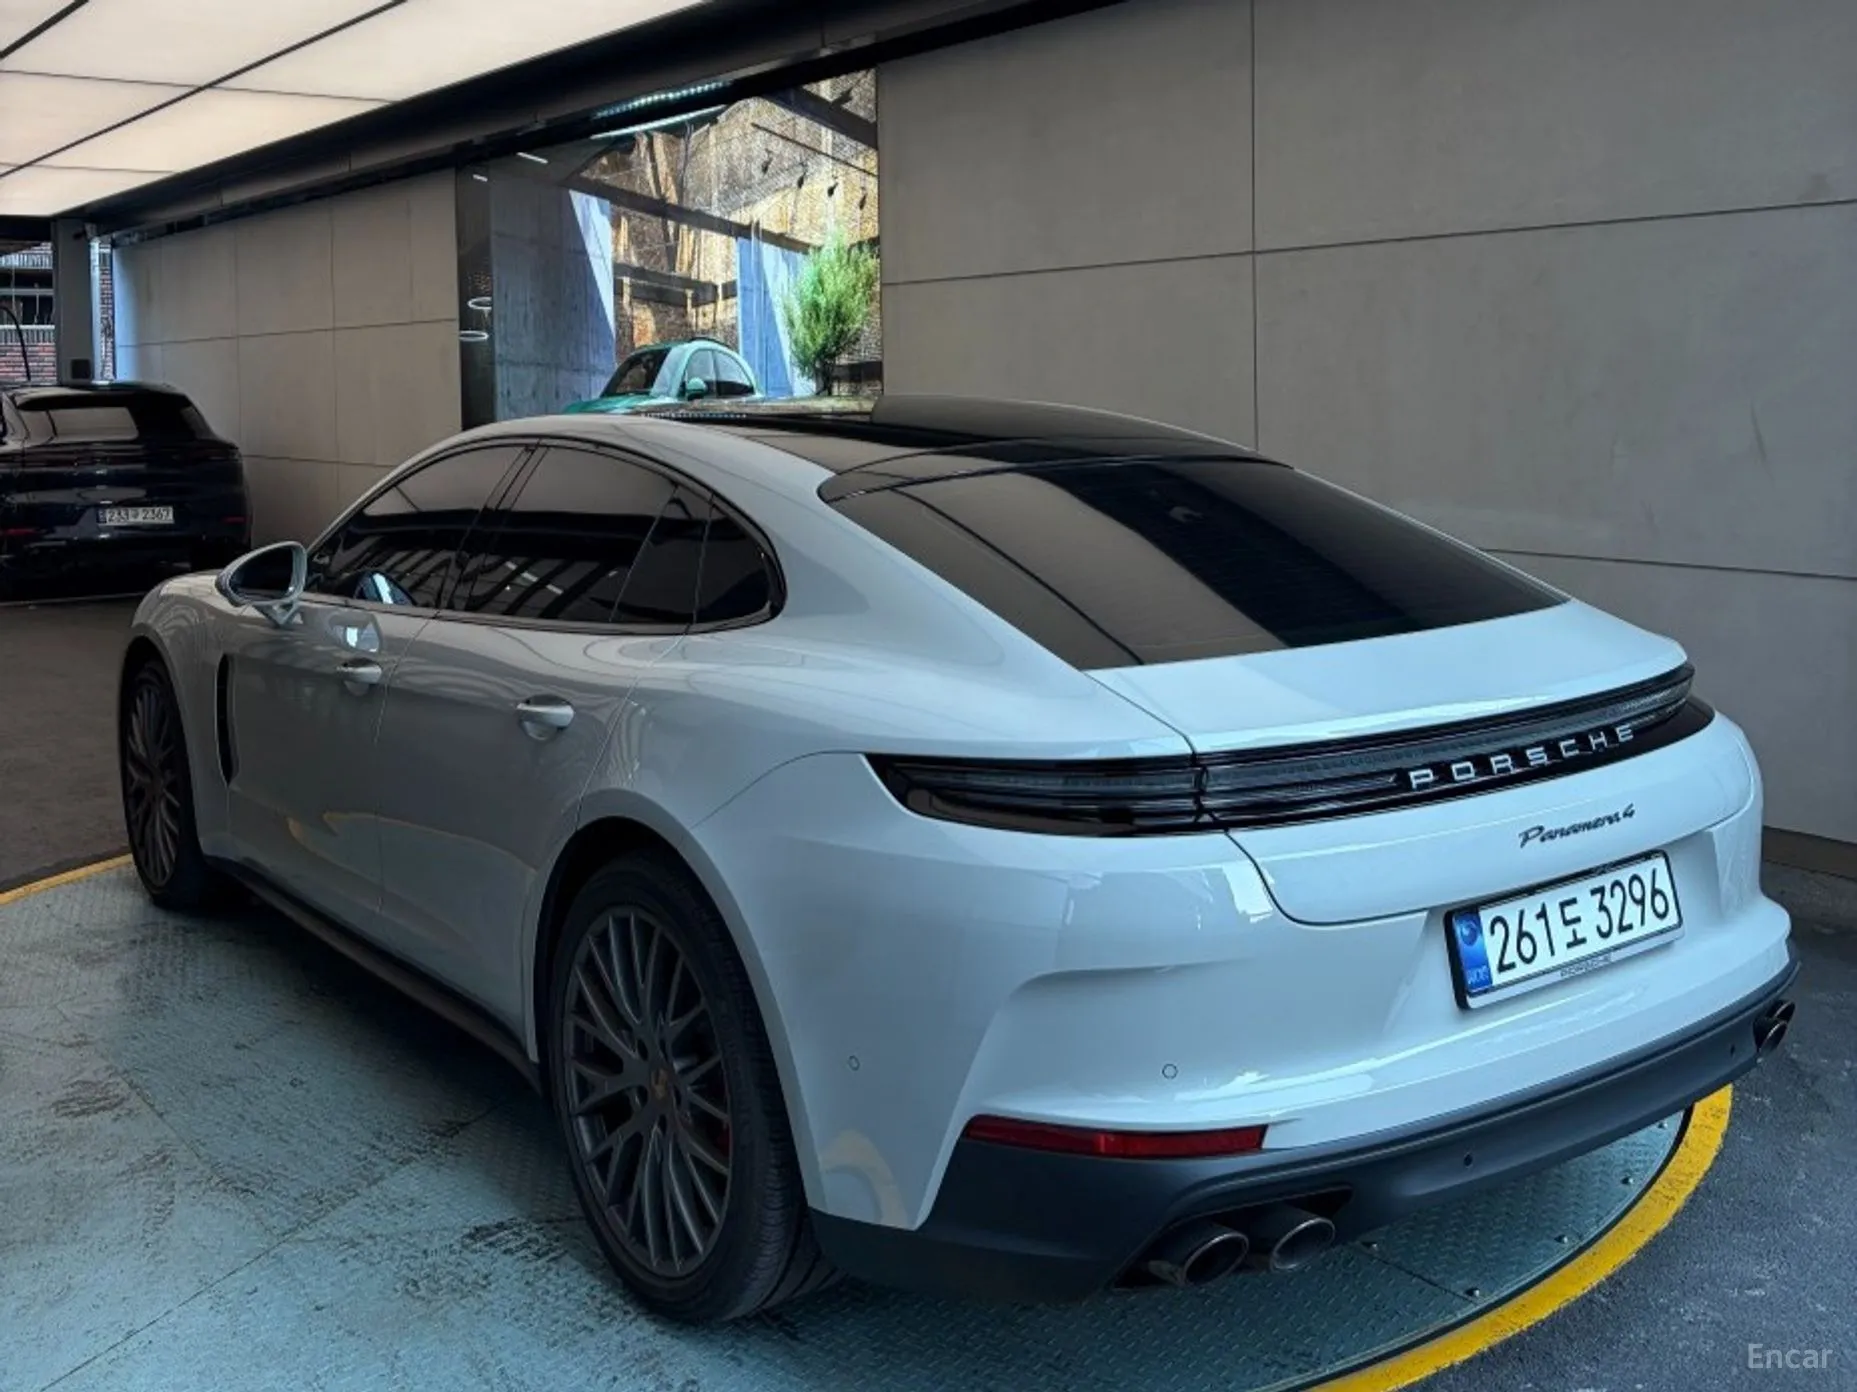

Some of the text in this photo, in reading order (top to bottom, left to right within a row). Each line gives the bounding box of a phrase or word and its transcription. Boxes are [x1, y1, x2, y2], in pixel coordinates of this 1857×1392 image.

[1409, 723, 1635, 790] PORSCHE
[1518, 809, 1622, 849] Panamera
[1489, 867, 1670, 974] 261도 3296
